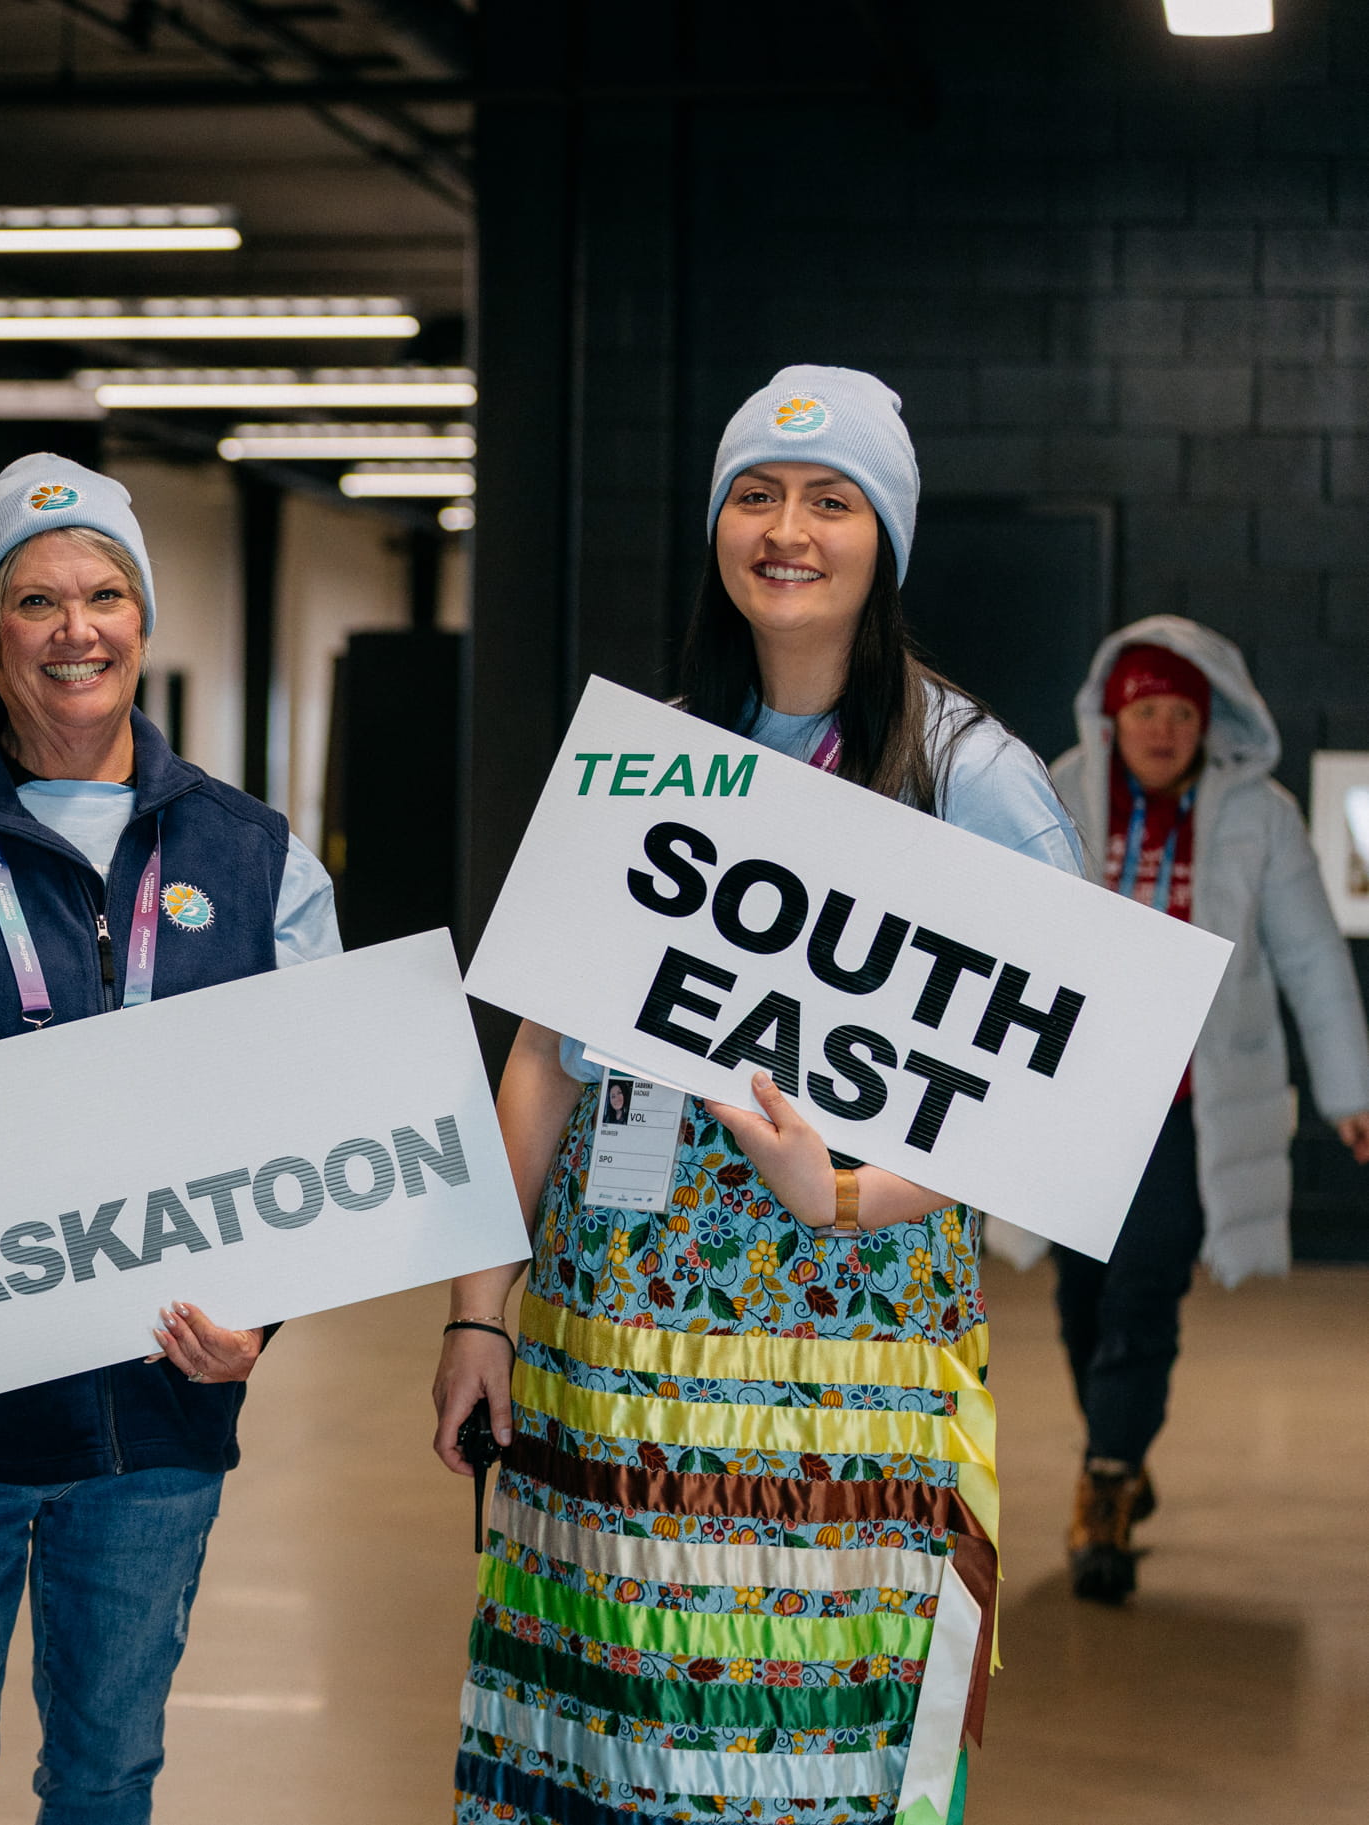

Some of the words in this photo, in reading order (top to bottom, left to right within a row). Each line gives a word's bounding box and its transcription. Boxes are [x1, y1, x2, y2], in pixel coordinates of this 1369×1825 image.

[574, 753, 759, 798] TEAM
[138, 927, 150, 969] SaskEnergy
[627, 821, 1087, 1079] SOUTH
[634, 946, 991, 1154] EAST
[630, 1112, 647, 1123] VOL
[598, 1154, 613, 1163] SPO
